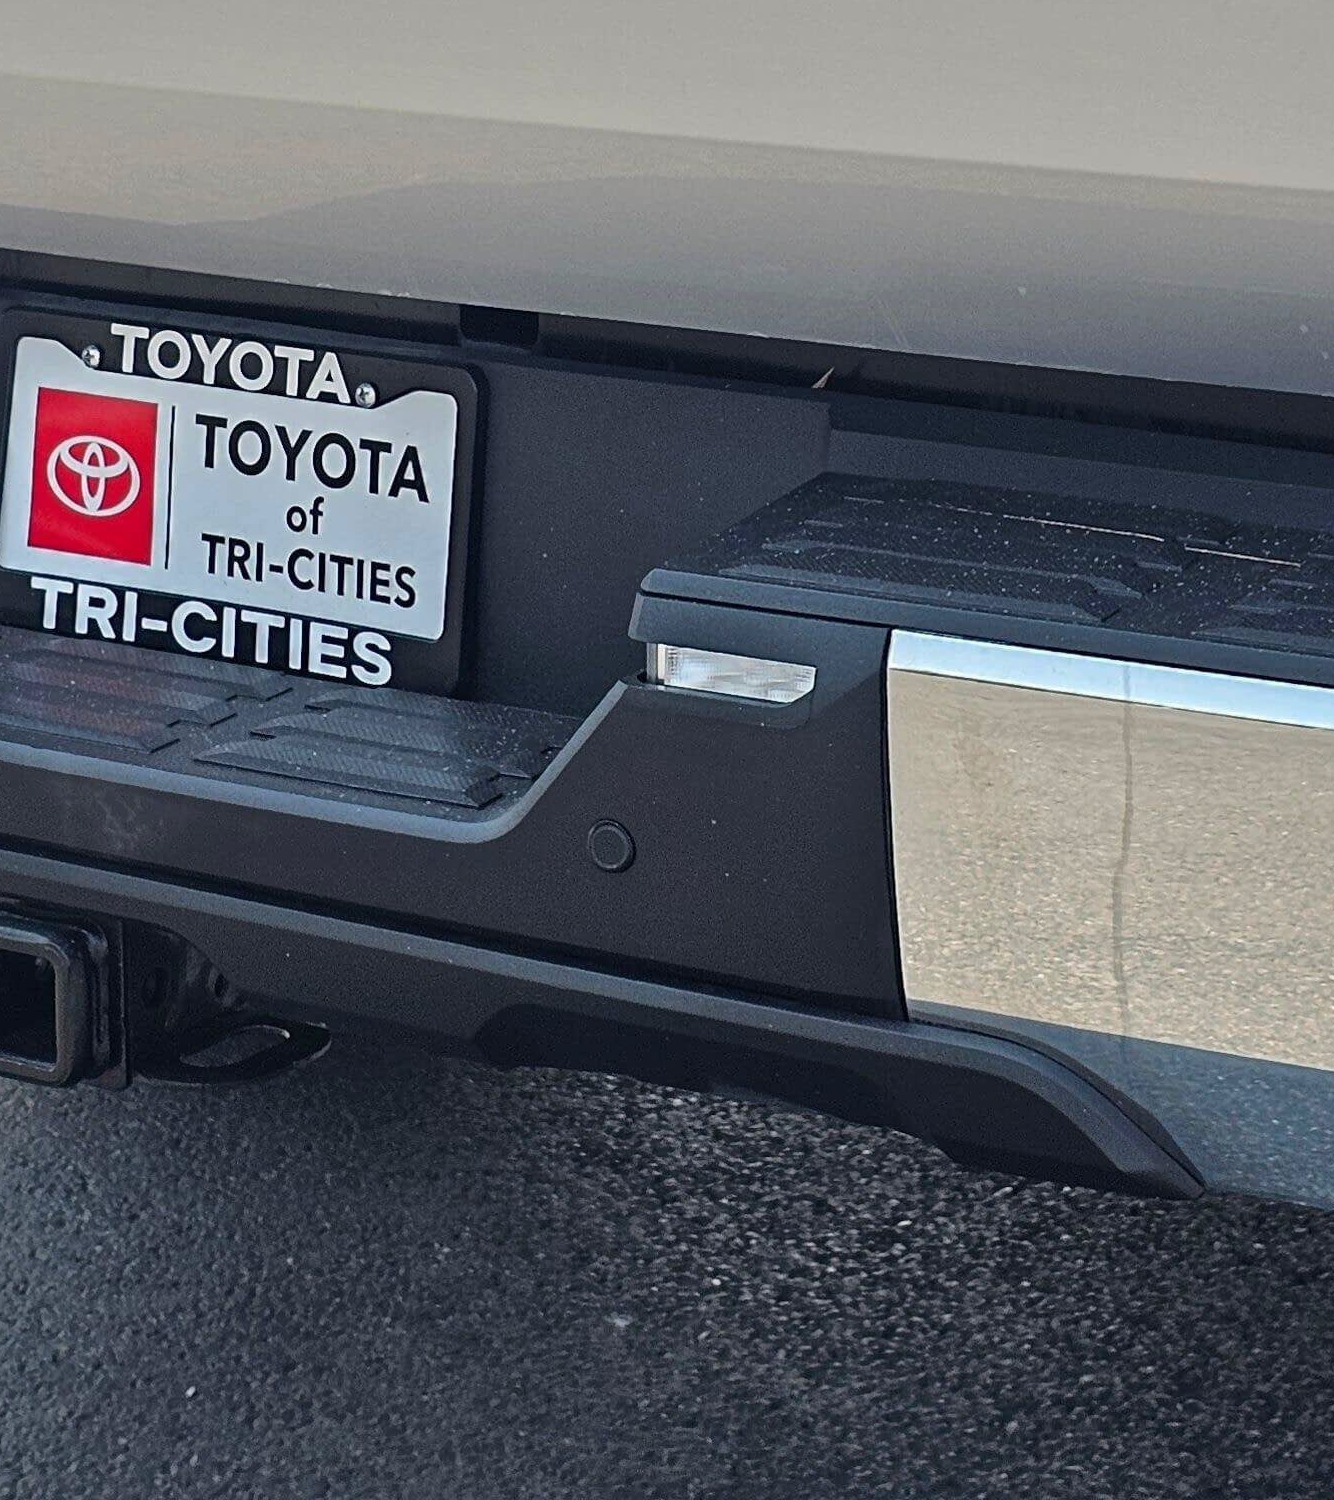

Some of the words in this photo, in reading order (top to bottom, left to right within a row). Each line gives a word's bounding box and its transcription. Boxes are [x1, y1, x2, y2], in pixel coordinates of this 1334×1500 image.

[110, 323, 351, 404] TOYOTA
[195, 414, 430, 503] TOYOTA
[286, 497, 324, 535] of
[201, 533, 416, 608] TRI-CITIES
[30, 577, 393, 686] TRI-CITIES
